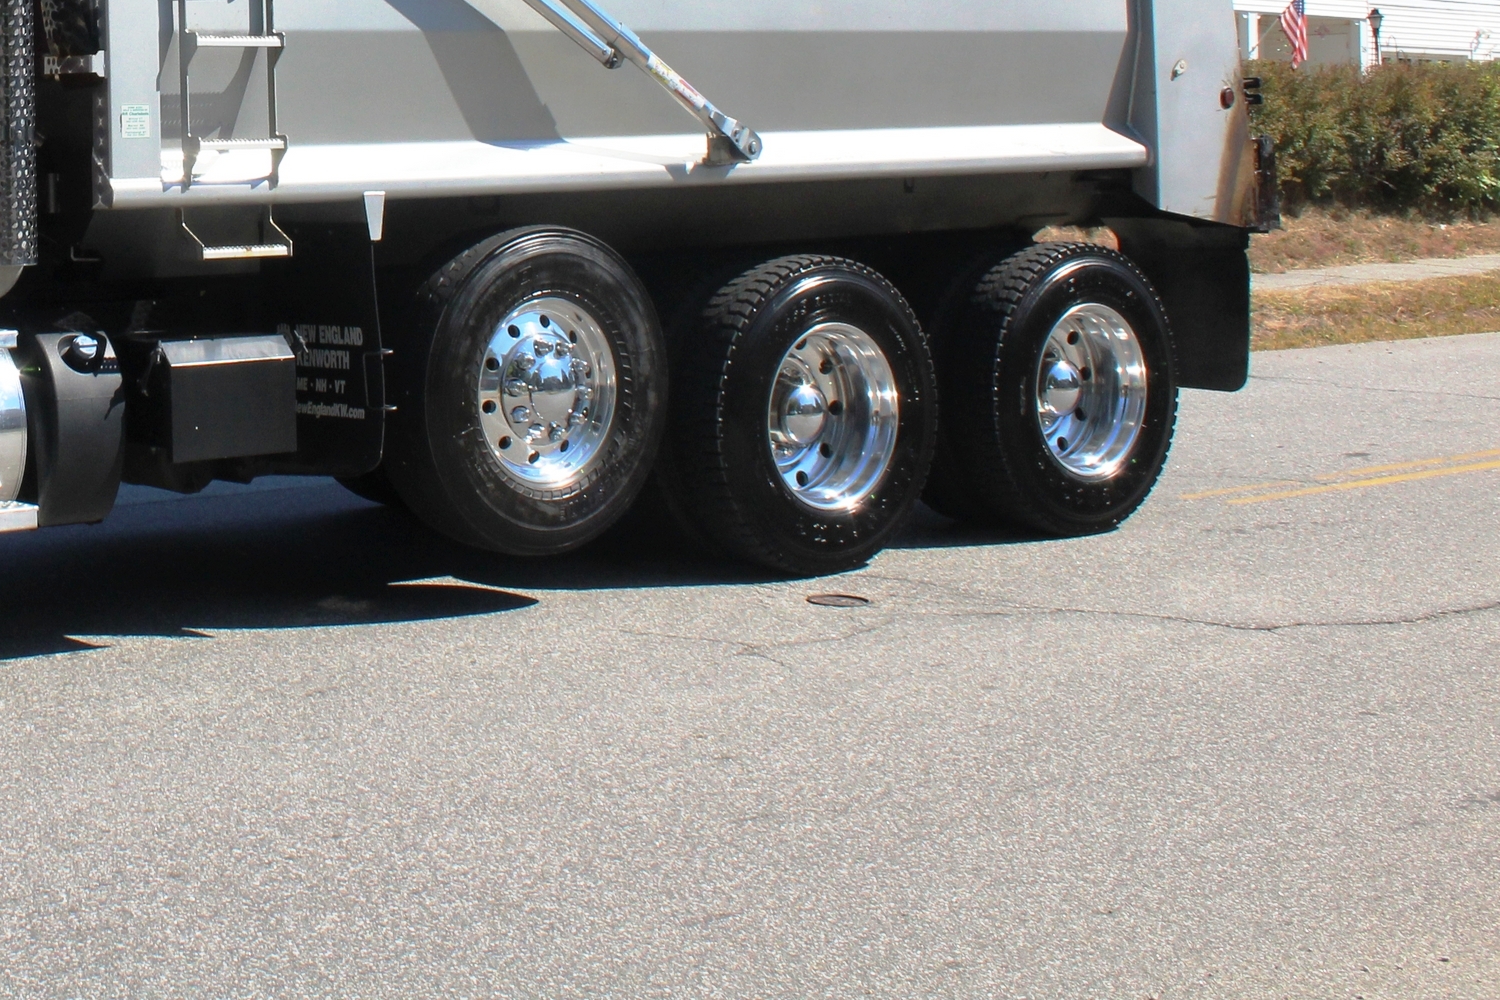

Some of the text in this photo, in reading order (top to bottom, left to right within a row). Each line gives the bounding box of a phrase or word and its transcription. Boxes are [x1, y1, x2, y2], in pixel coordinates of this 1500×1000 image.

[295, 324, 363, 346] NEW ENGLAND
[296, 350, 350, 369] KENWORTH
[315, 378, 328, 392] NH
[334, 379, 347, 394] VT
[296, 401, 365, 419] ewEnglandKW.com
